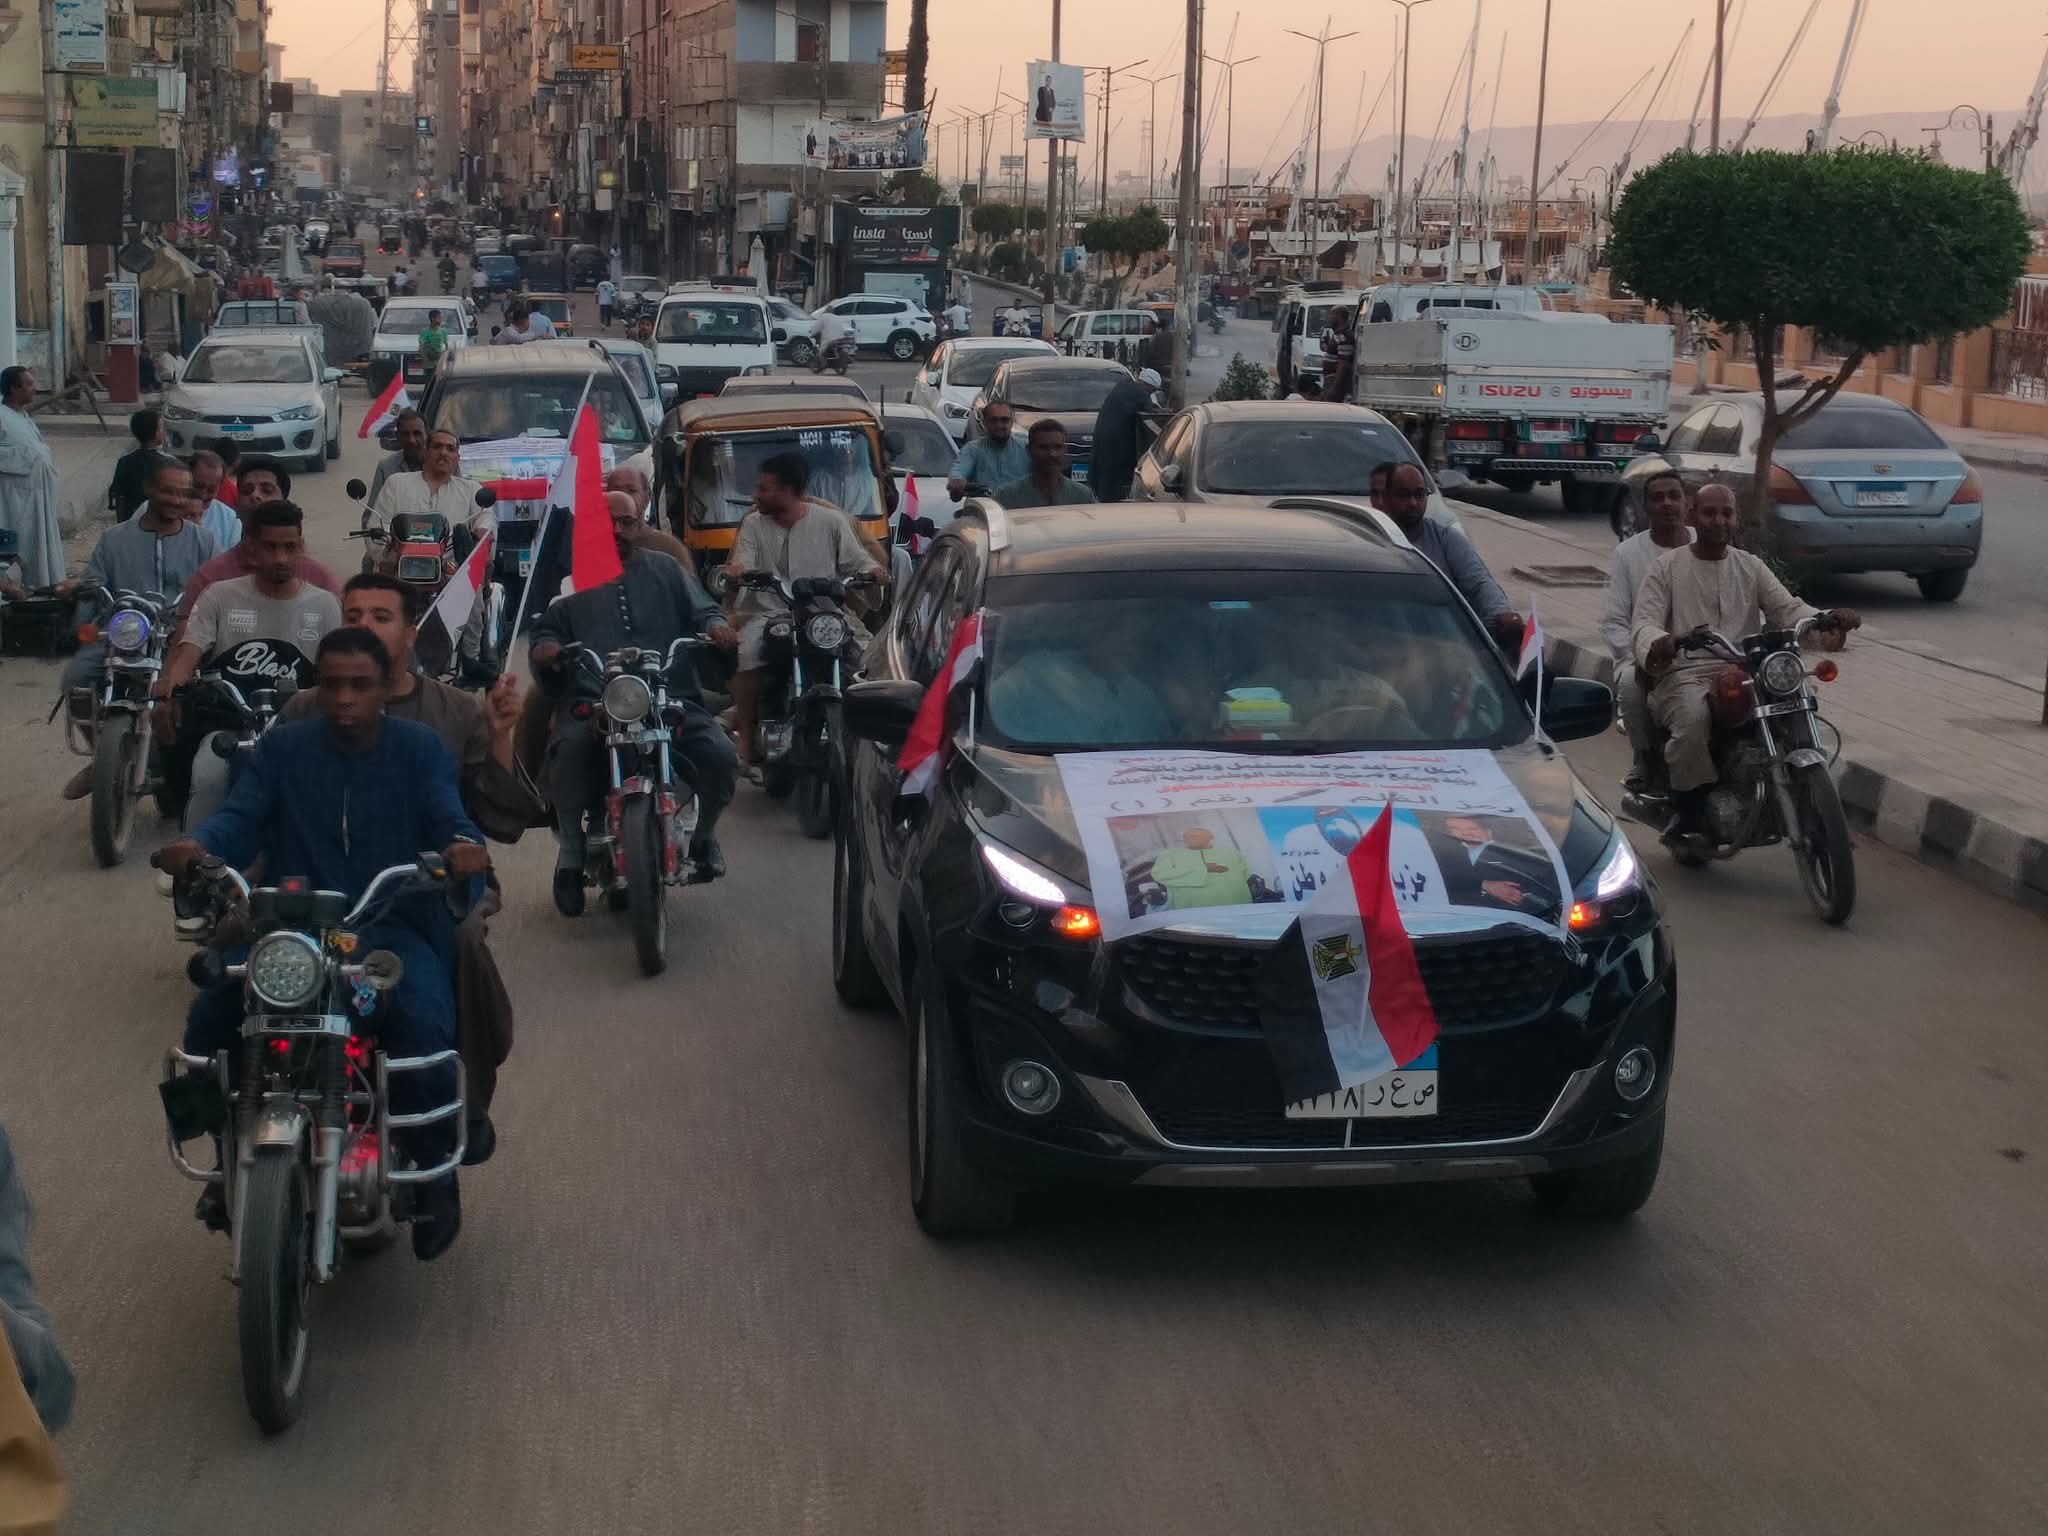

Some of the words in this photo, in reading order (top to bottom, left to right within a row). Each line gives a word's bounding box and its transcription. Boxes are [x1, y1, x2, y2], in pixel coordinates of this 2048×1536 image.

[853, 226, 886, 239] insta
[1479, 384, 1541, 397] ISUZU
[226, 641, 301, 681] Black
[1191, 794, 1253, 807] رقم
[1351, 792, 1440, 805] القلم
[1457, 800, 1515, 813] رمز
[1391, 863, 1427, 902] حزب
